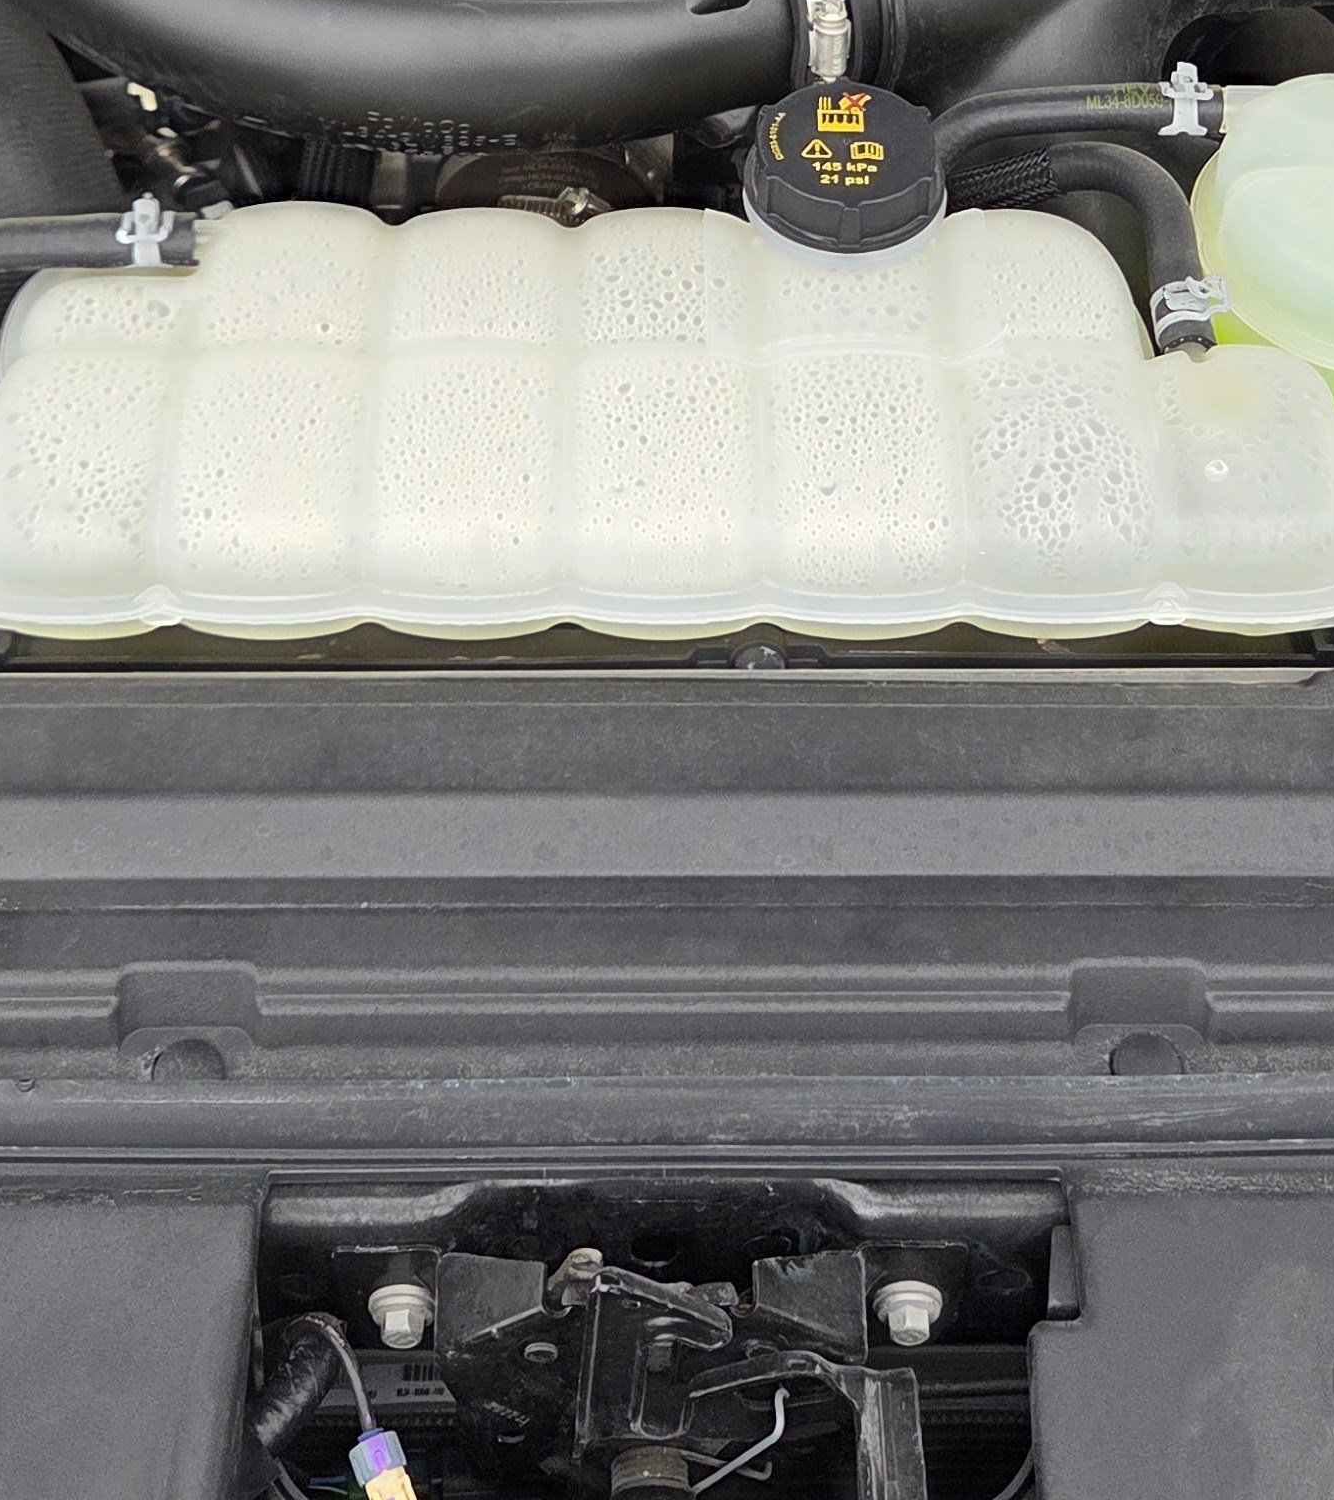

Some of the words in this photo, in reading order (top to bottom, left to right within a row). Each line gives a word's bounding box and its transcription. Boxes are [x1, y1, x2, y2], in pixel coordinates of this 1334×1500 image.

[811, 161, 843, 172] 145
[846, 161, 878, 173] kPa
[819, 174, 839, 185] 21
[844, 174, 870, 186] psi
